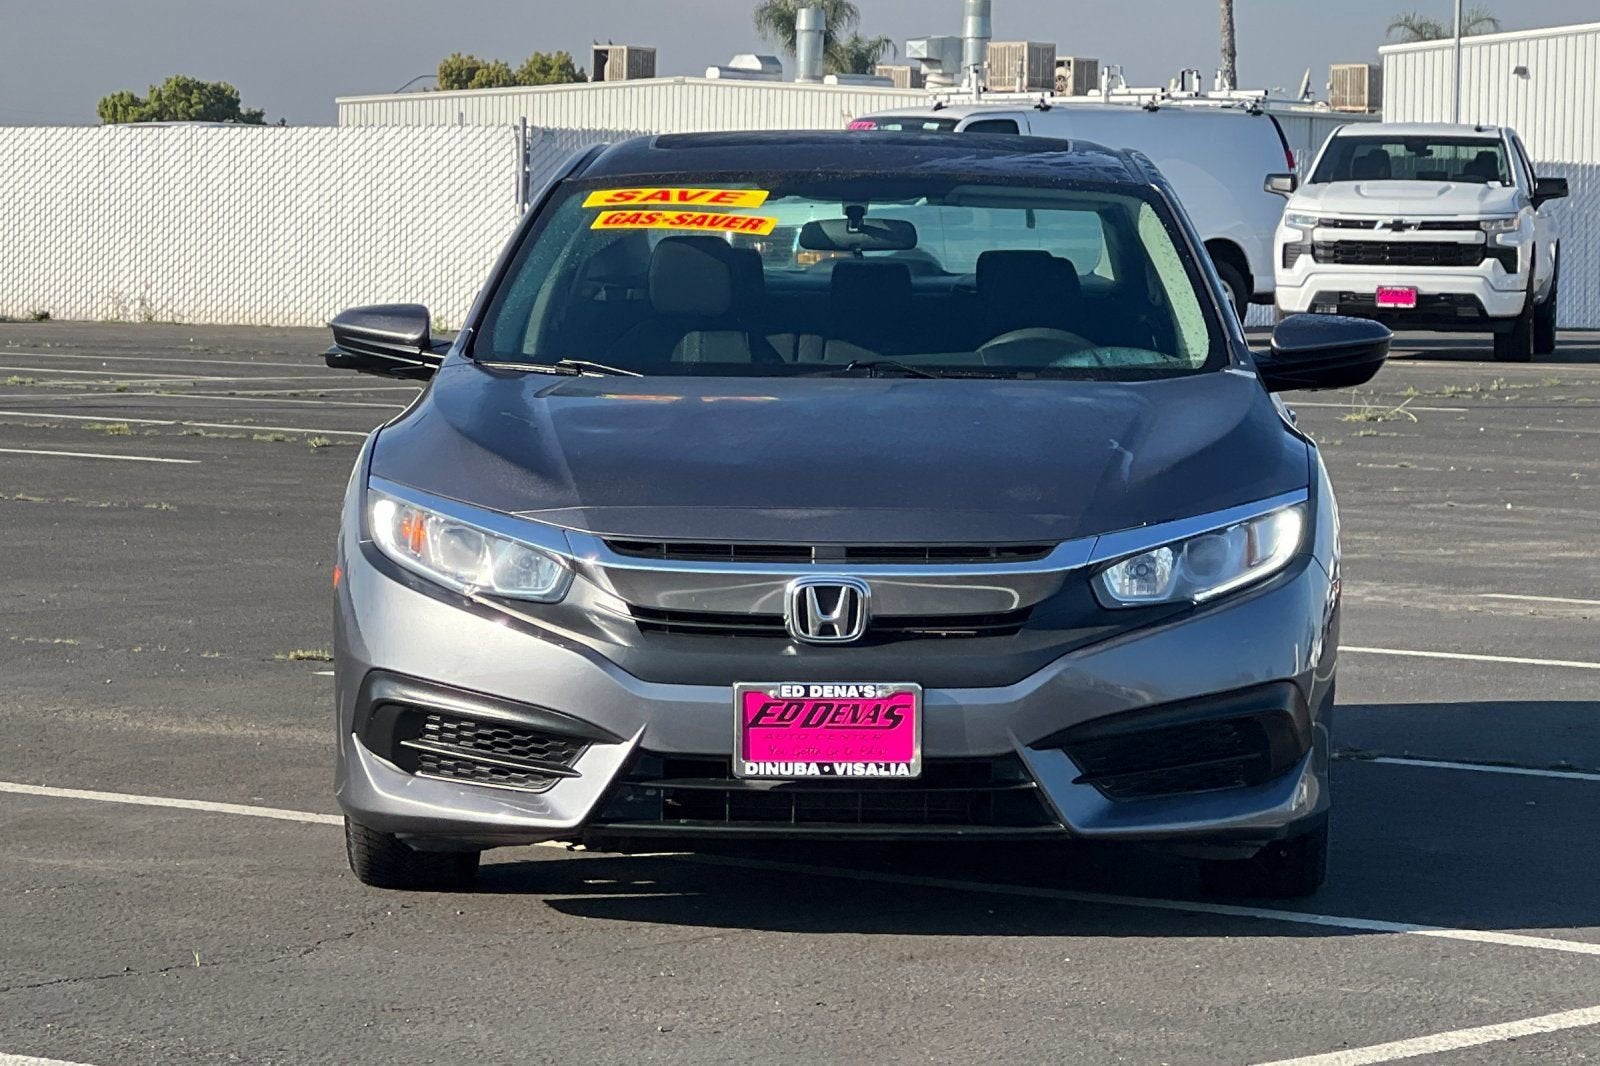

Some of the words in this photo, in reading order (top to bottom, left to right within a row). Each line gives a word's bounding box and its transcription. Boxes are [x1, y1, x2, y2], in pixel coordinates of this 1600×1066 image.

[605, 189, 747, 204] SAVE
[602, 212, 768, 230] GAS-SAVER
[781, 685, 805, 697] ED
[810, 685, 875, 698] DENA'S
[748, 702, 805, 728] ED
[745, 762, 820, 775] DINUBA
[833, 762, 909, 776] VISALIA
